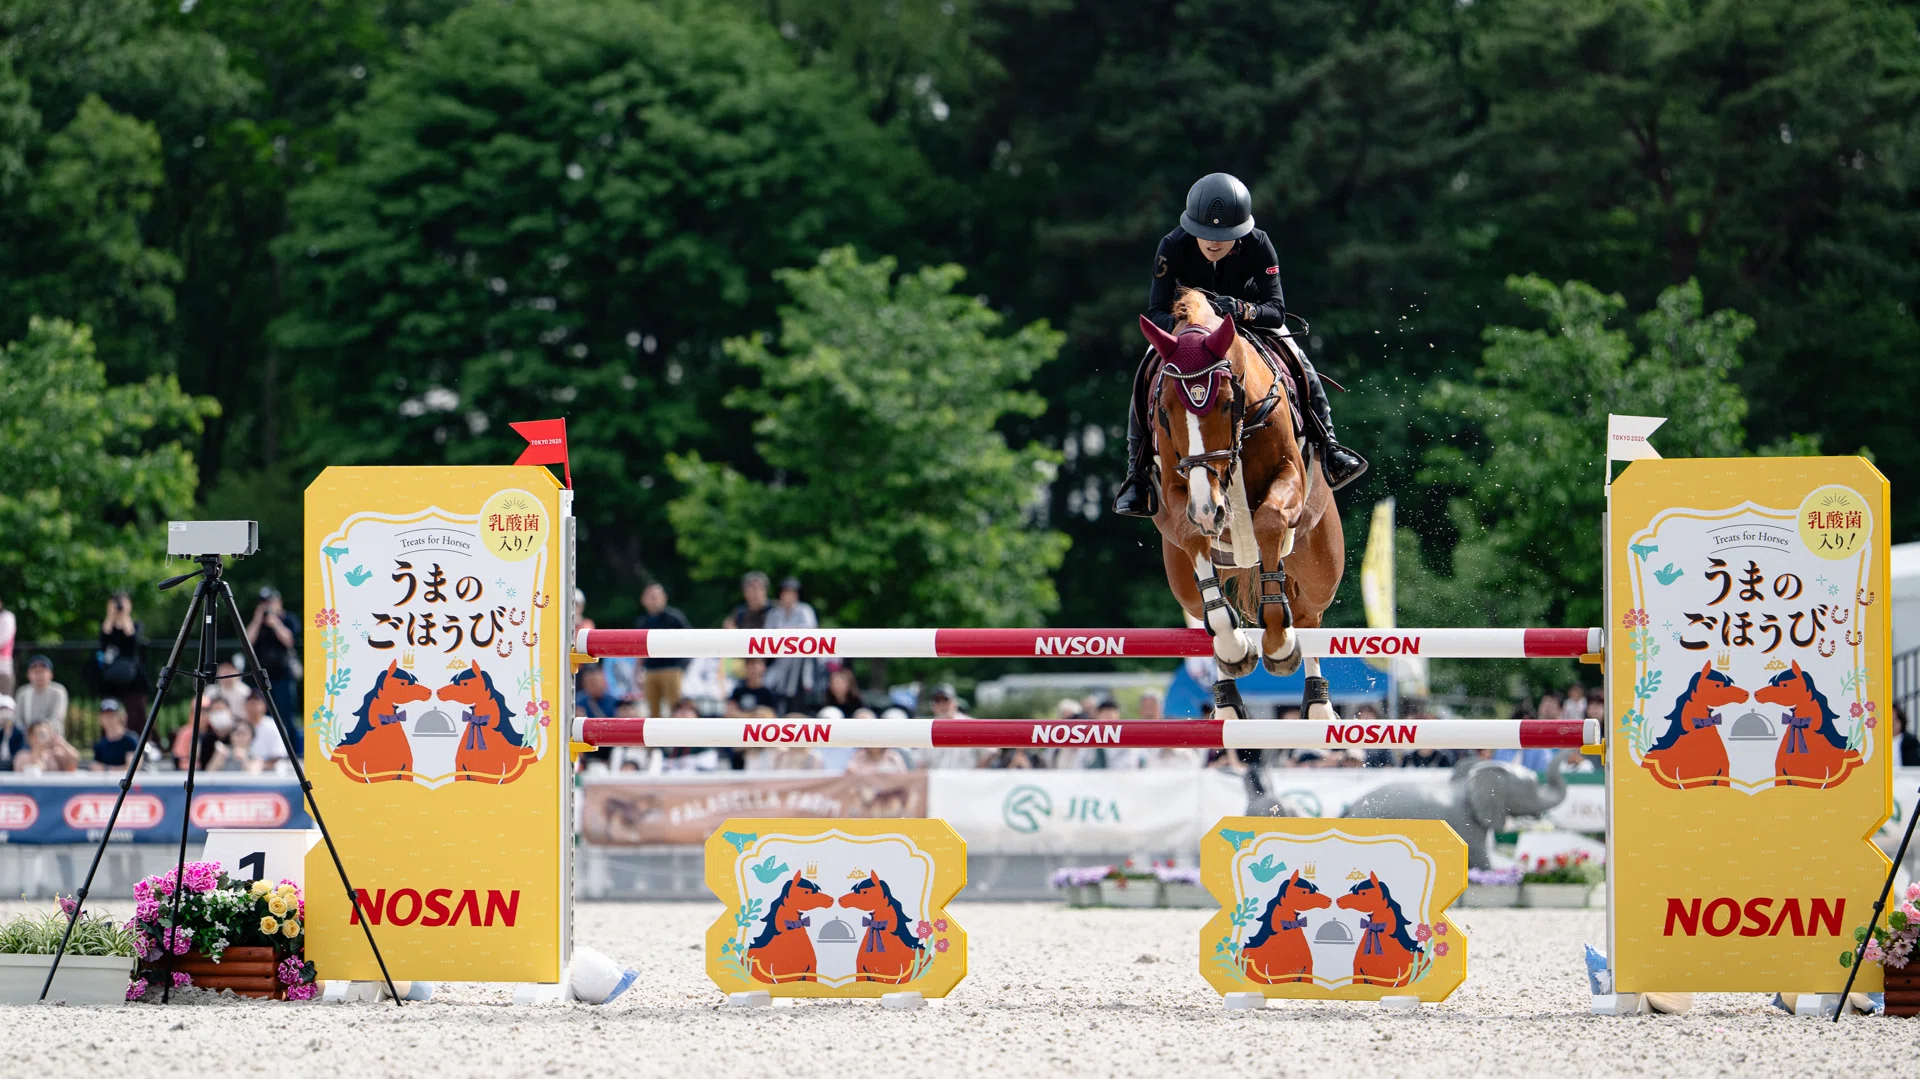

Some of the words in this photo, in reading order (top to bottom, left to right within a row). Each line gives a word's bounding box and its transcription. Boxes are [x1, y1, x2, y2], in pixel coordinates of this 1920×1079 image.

[531, 438, 549, 446] TOKYO
[488, 513, 540, 532] 乳酸菌
[1807, 511, 1863, 530] 乳酸菌
[400, 538, 426, 548] Treats
[428, 534, 440, 544] for
[442, 535, 471, 549] Horses
[1713, 533, 1740, 545] Treats
[1743, 530, 1756, 541] for
[1758, 531, 1789, 546] Horses
[391, 559, 484, 607] うまの
[1704, 556, 1804, 607] うまの
[367, 605, 507, 654] ごほうび
[1679, 604, 1829, 654] ごほうび
[742, 723, 832, 743] NOSAN
[1031, 724, 1123, 744] NOSAN
[1325, 724, 1418, 744] NOSAN
[1064, 796, 1122, 822] JRA
[239, 852, 265, 881] 1
[349, 888, 521, 928] NOSAN
[1663, 897, 1846, 937] NOSAN
